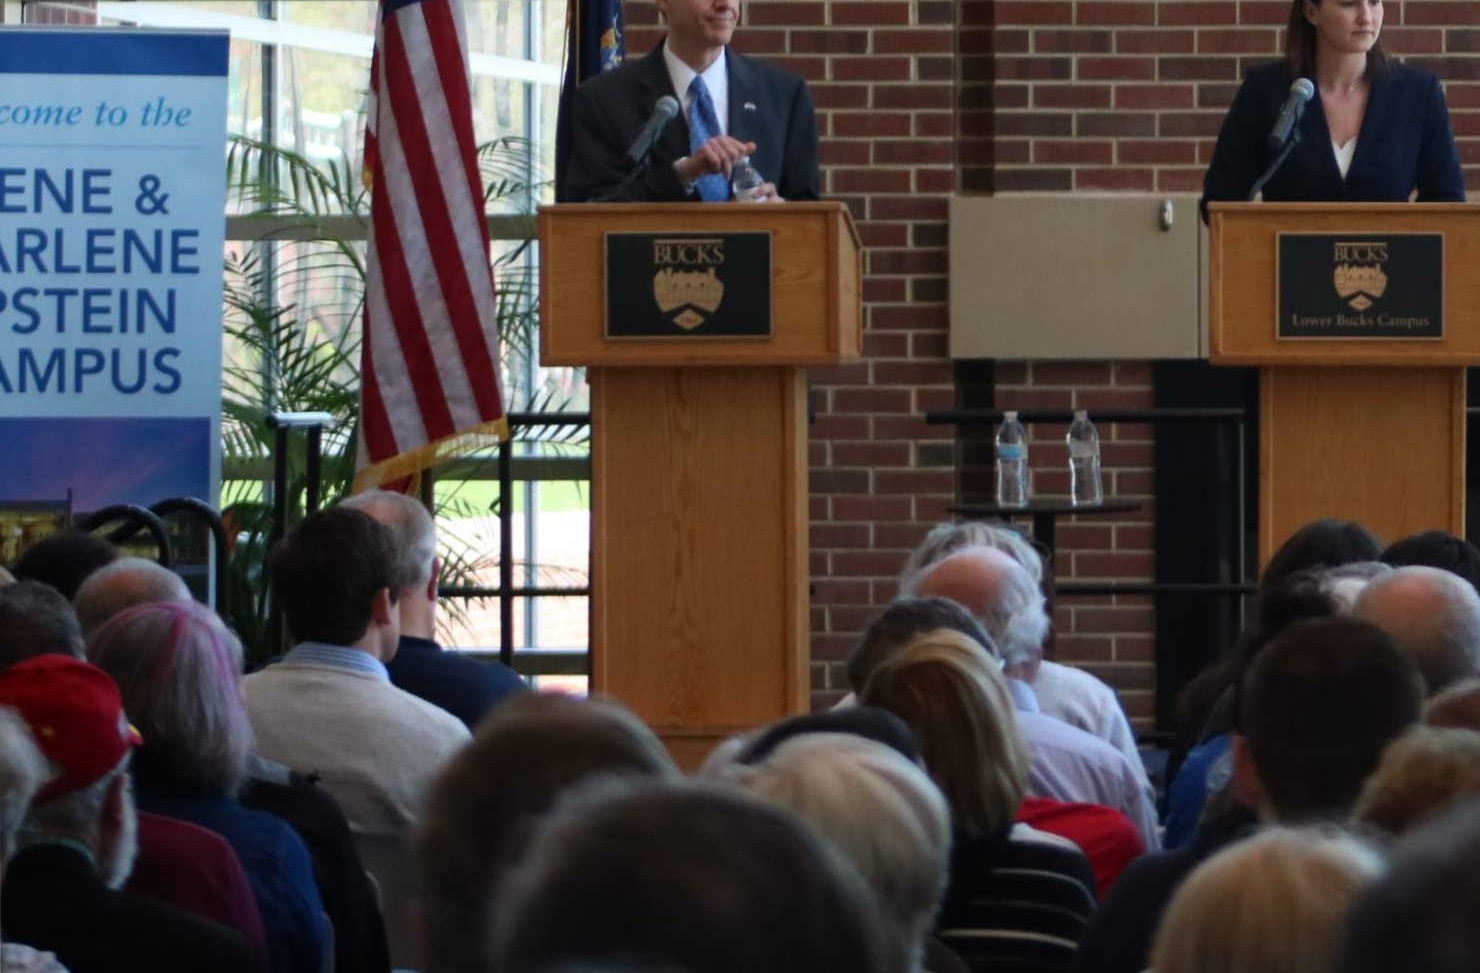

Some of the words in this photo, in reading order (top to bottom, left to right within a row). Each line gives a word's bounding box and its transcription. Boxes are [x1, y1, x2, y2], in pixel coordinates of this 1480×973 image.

[95, 101, 128, 126] to
[141, 96, 192, 127] the
[0, 168, 113, 214] ENE
[135, 174, 170, 215] &
[654, 243, 725, 264] BUCKS
[1333, 246, 1389, 262] BUCKS
[0, 287, 176, 334] STEIN
[1292, 314, 1332, 327] Lower
[1336, 314, 1374, 327] Bucks
[1377, 314, 1430, 330] Campus
